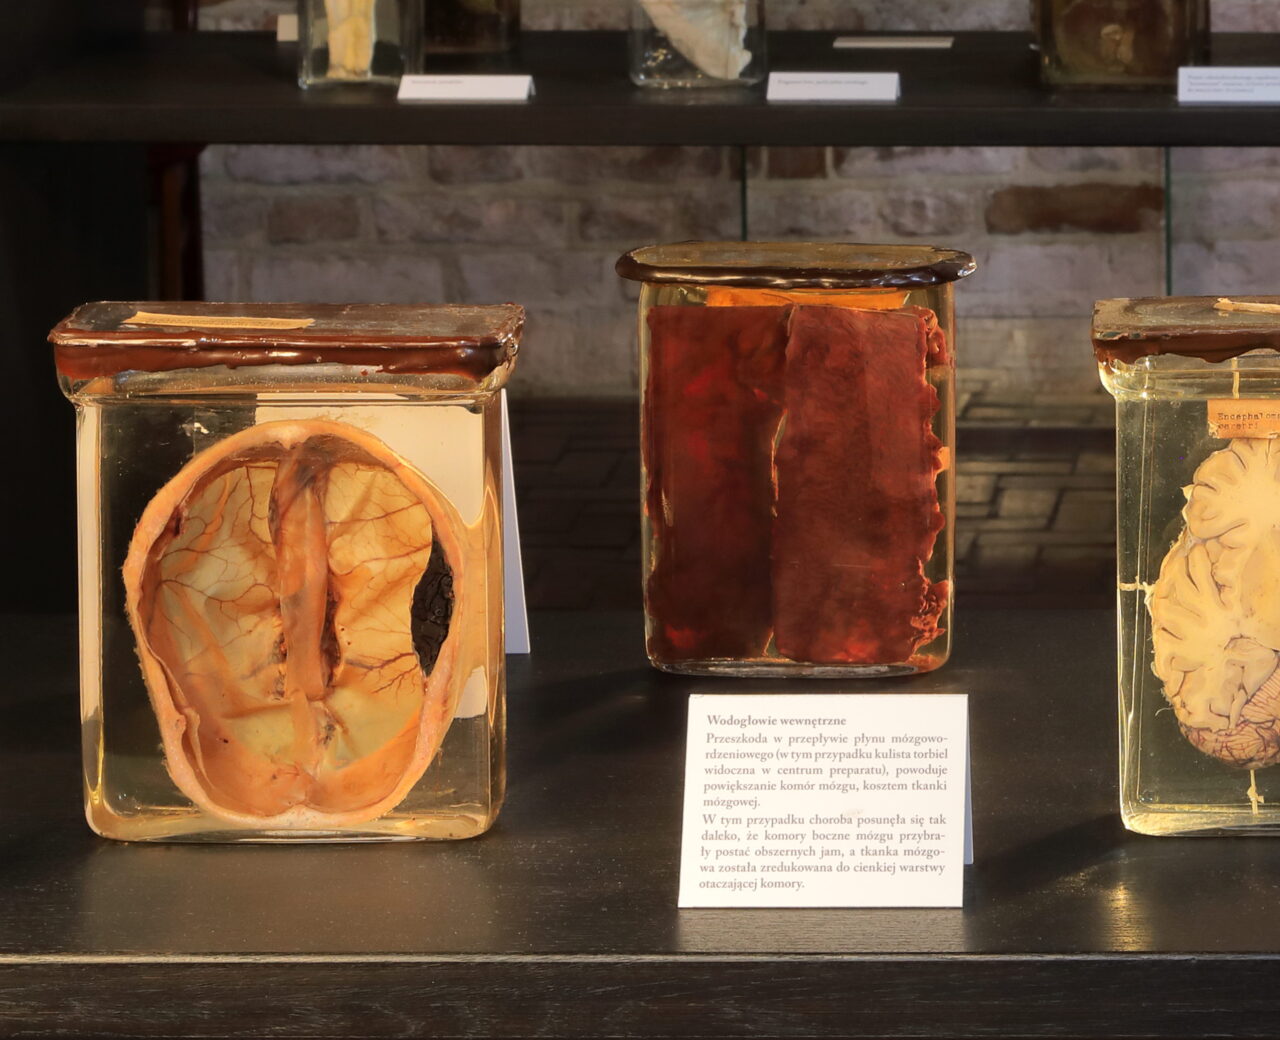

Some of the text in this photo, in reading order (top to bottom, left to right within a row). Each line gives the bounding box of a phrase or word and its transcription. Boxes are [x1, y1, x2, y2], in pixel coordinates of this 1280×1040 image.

[707, 714, 847, 729] Wodogłowie wewnętrzne
[706, 732, 948, 747] Przeszkoda przepływie płynu mózgowo-
[705, 748, 948, 763] rdzeniowego tym przypadku kulista torbiel
[704, 763, 948, 779] widoczna centrum preparatu), powoduje
[703, 779, 947, 794] powiększanie komór mózgu, kosztem tkanki
[703, 796, 761, 810] mózgowej.
[720, 813, 947, 829] tym przypadku choroba posunęła się tak
[701, 829, 946, 844] daleko, komory boczne mózgu przybra-
[715, 845, 945, 861] postać obszernych jam, tkanka mózgo-
[718, 861, 946, 876] została zredukowana cienkiej warstwy
[698, 877, 805, 892] otaczającej komory.
